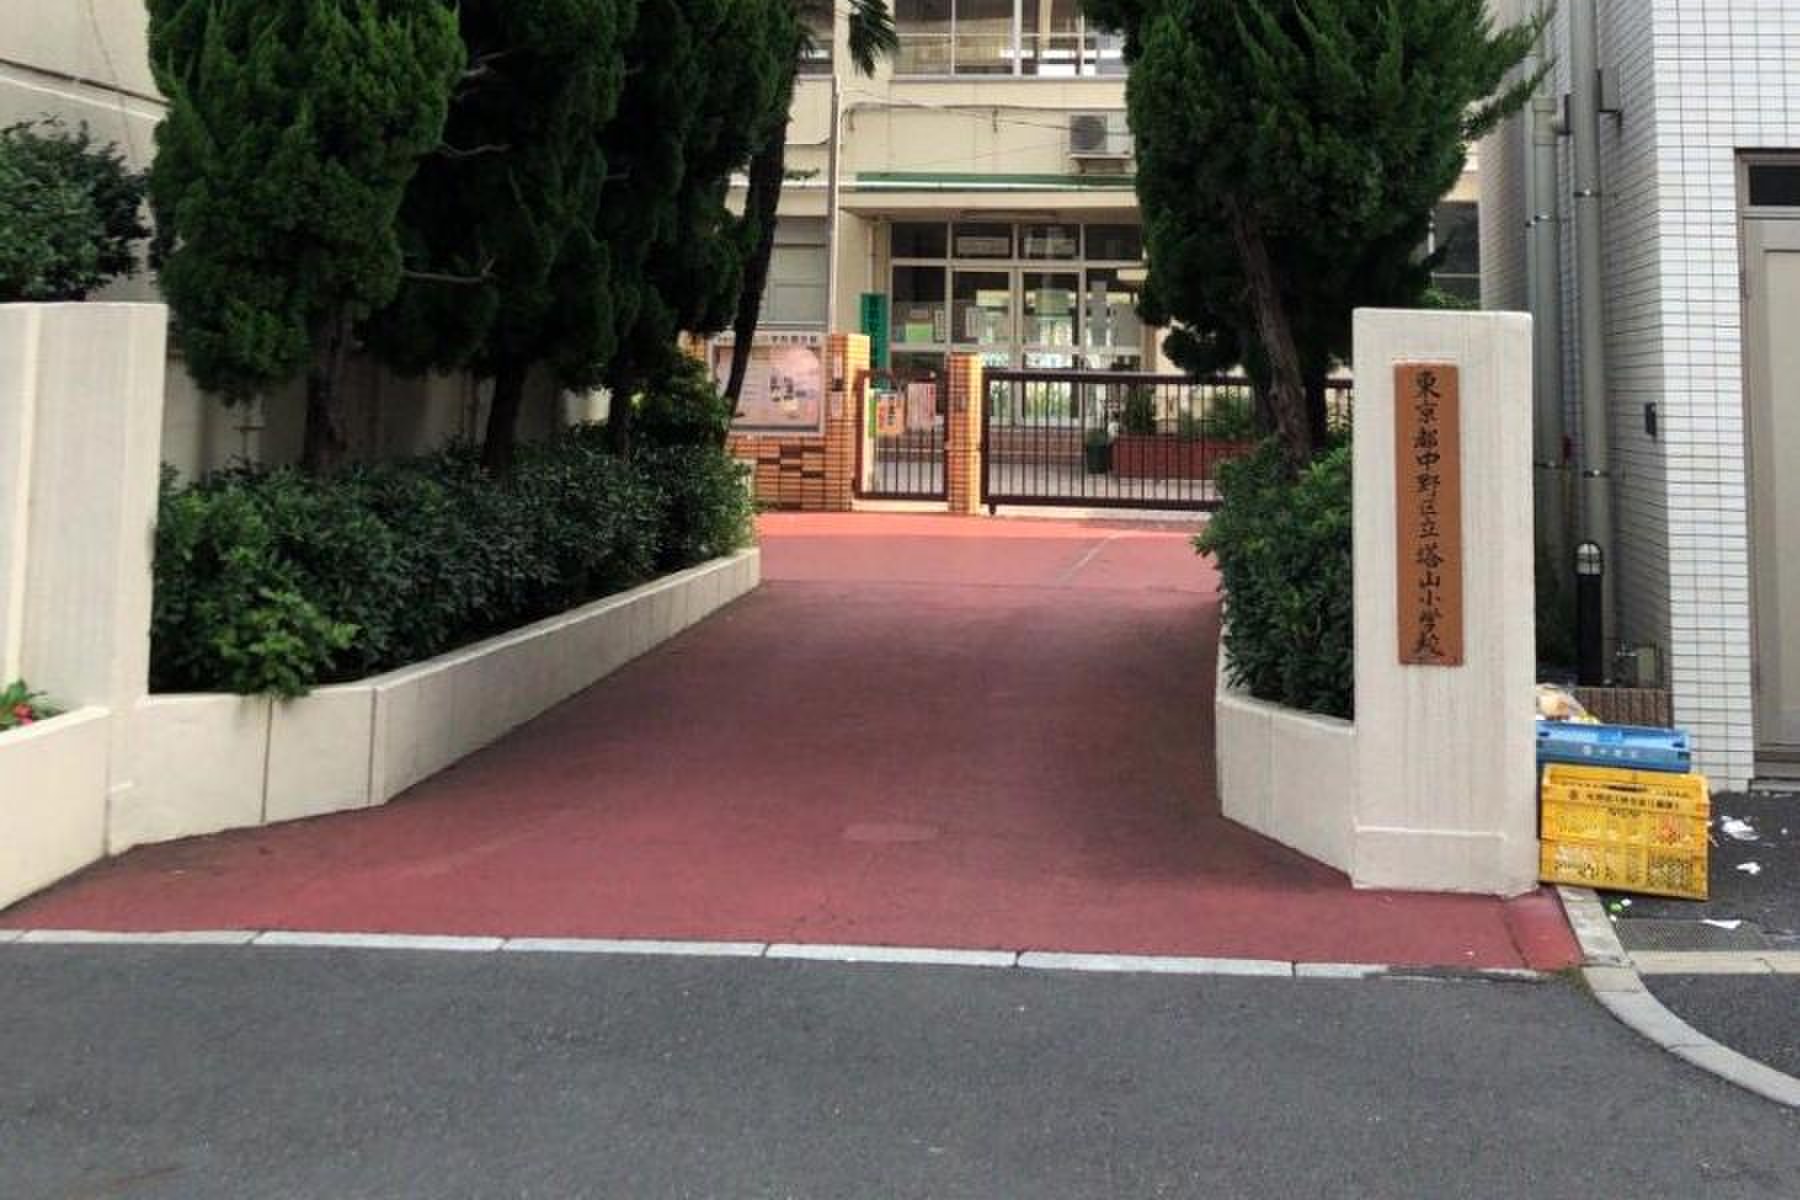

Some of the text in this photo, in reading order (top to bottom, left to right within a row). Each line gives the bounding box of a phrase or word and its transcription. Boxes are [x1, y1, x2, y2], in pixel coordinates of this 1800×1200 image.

[1413, 370, 1444, 657] 東京都中野区立塔山小学校
